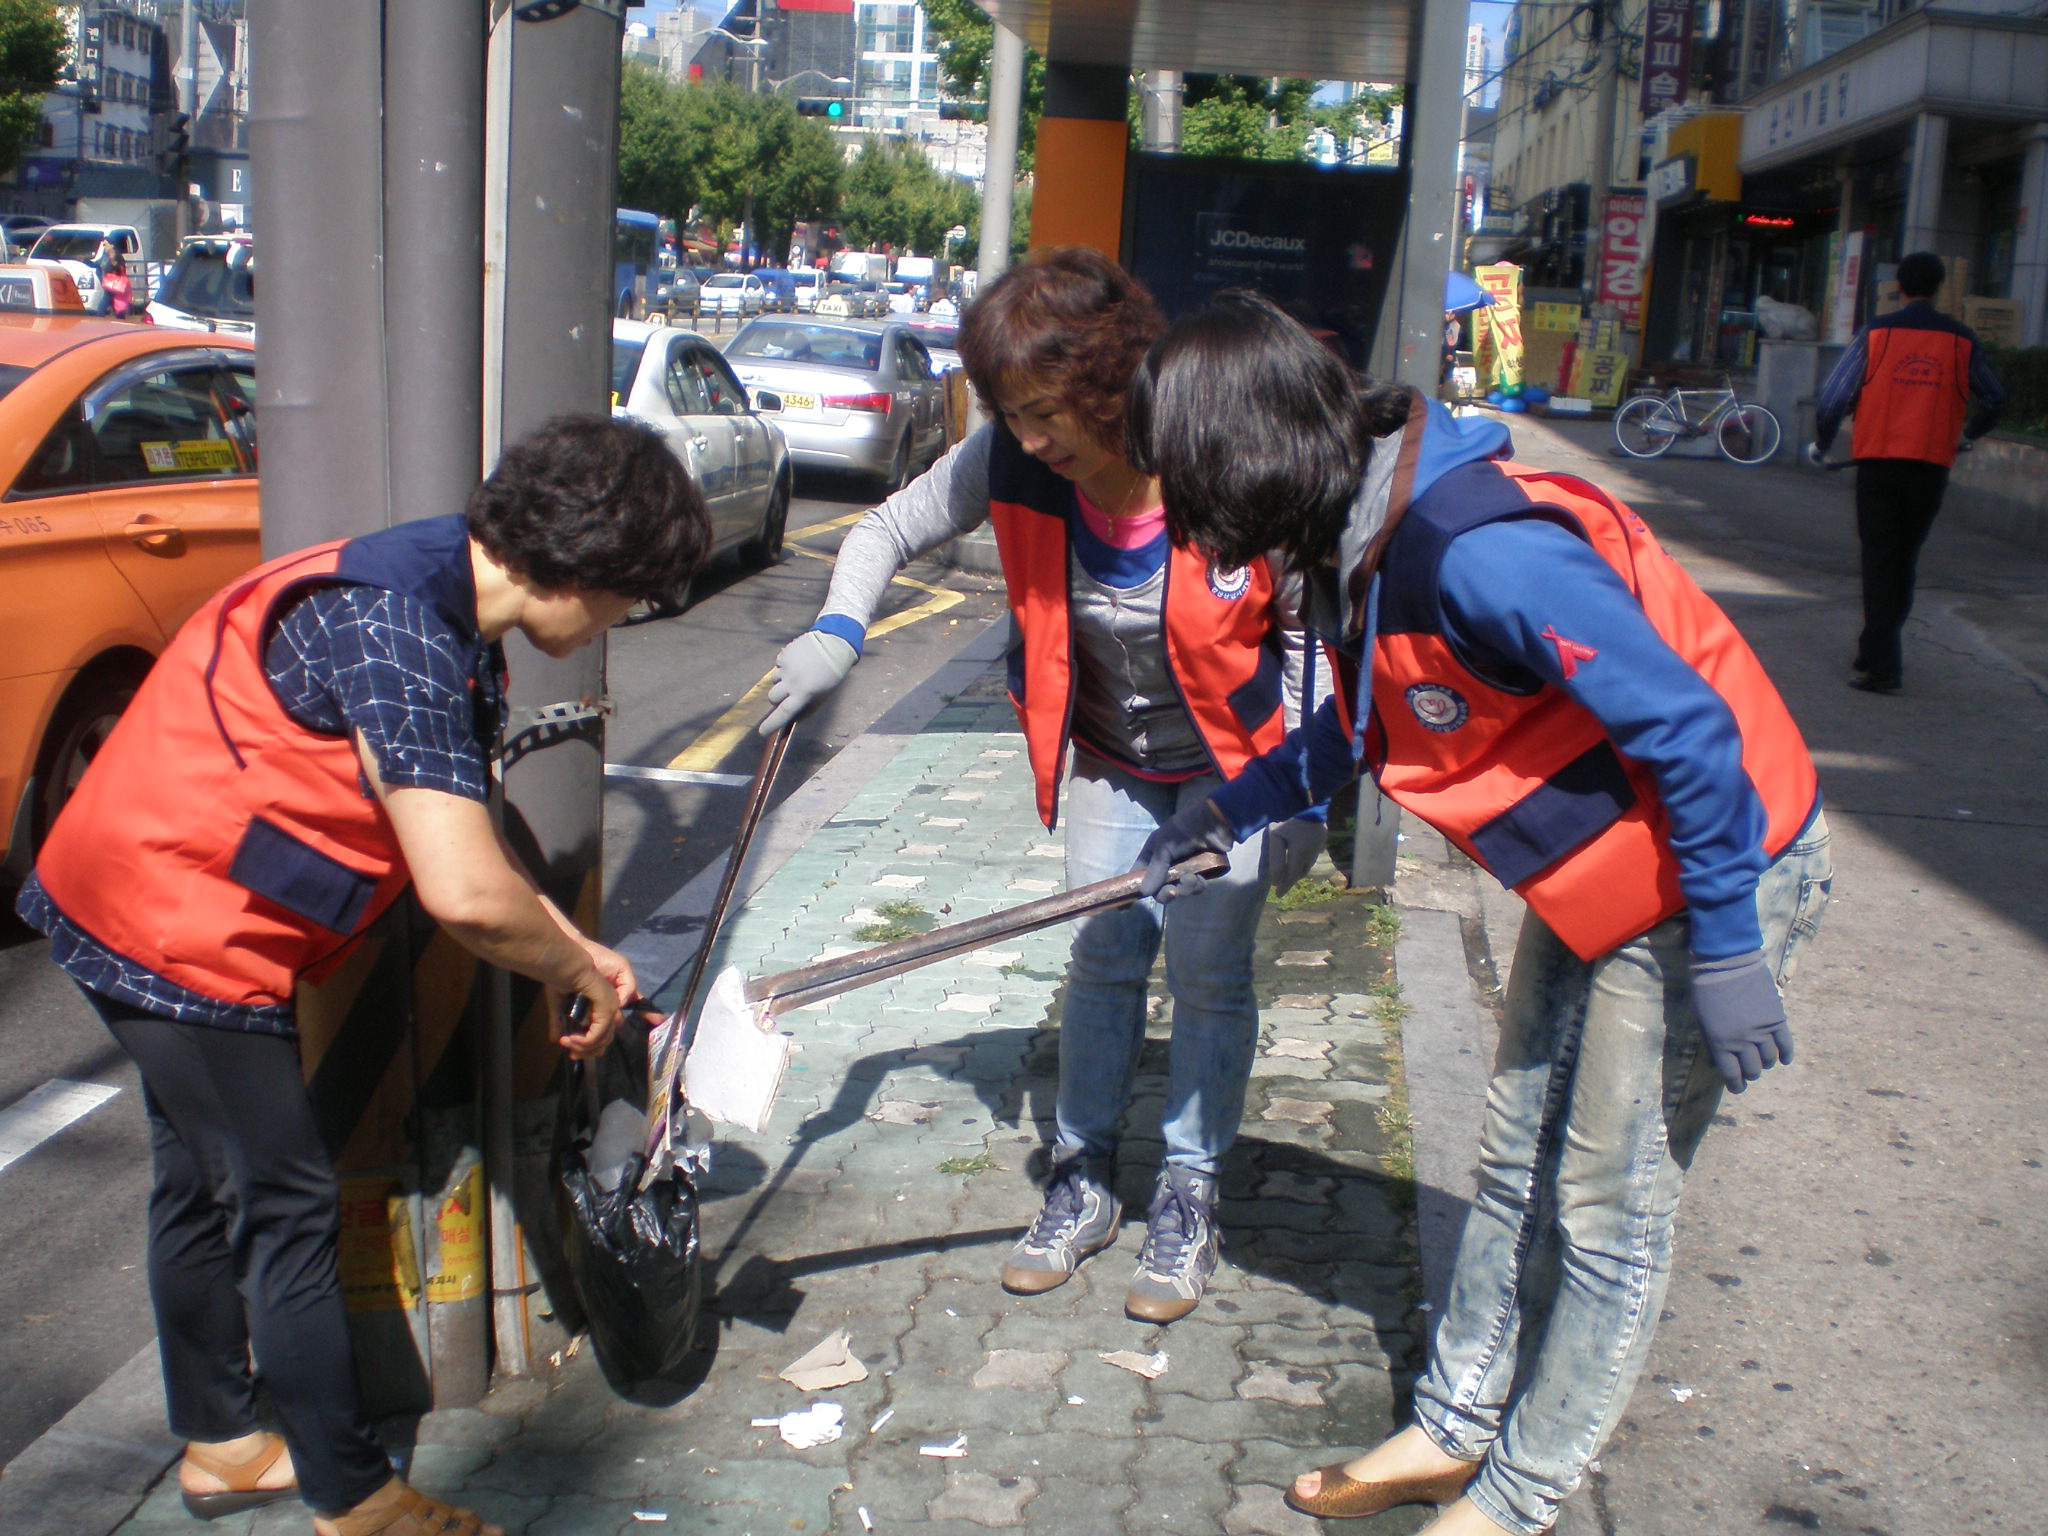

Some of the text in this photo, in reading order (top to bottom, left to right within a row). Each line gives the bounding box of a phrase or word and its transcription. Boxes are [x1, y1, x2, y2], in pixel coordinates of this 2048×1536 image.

[1649, 12, 1684, 96] 커피숍
[1210, 229, 1305, 251] JCDecaux
[821, 303, 842, 314] TAXI
[1589, 354, 1616, 396] 공짜
